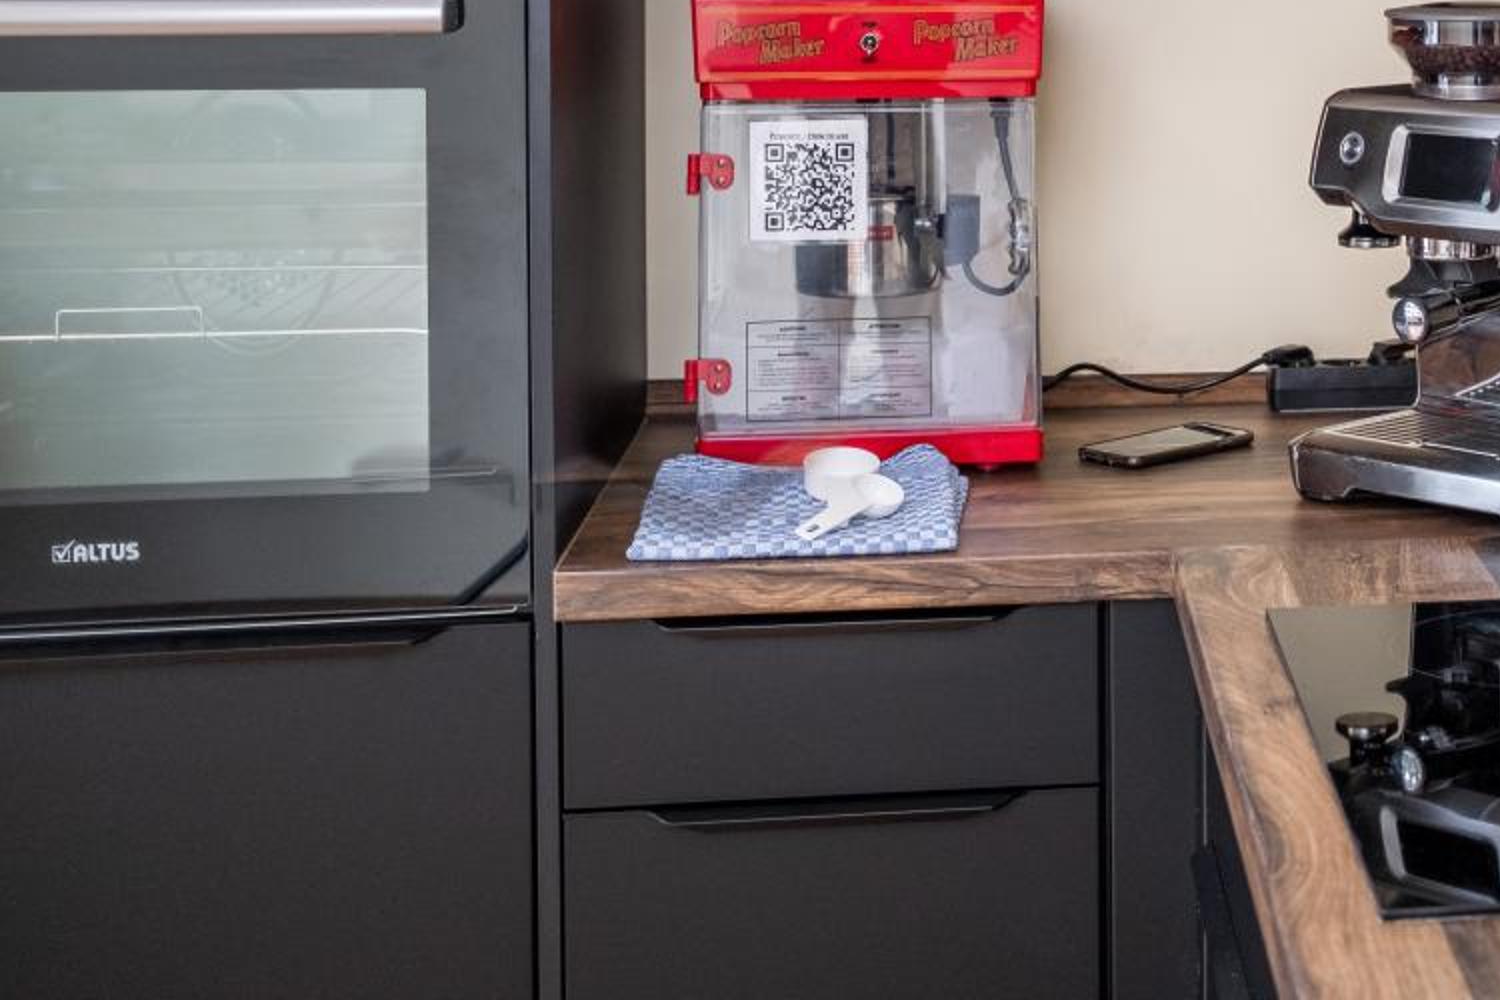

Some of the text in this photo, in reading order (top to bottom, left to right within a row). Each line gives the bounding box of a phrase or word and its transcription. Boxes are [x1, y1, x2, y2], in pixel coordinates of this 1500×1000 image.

[717, 20, 800, 48] Popcorn
[914, 18, 994, 45] Popcorn
[759, 36, 825, 64] Maker
[954, 35, 1018, 62] Maker
[73, 542, 140, 563] ALTUS
